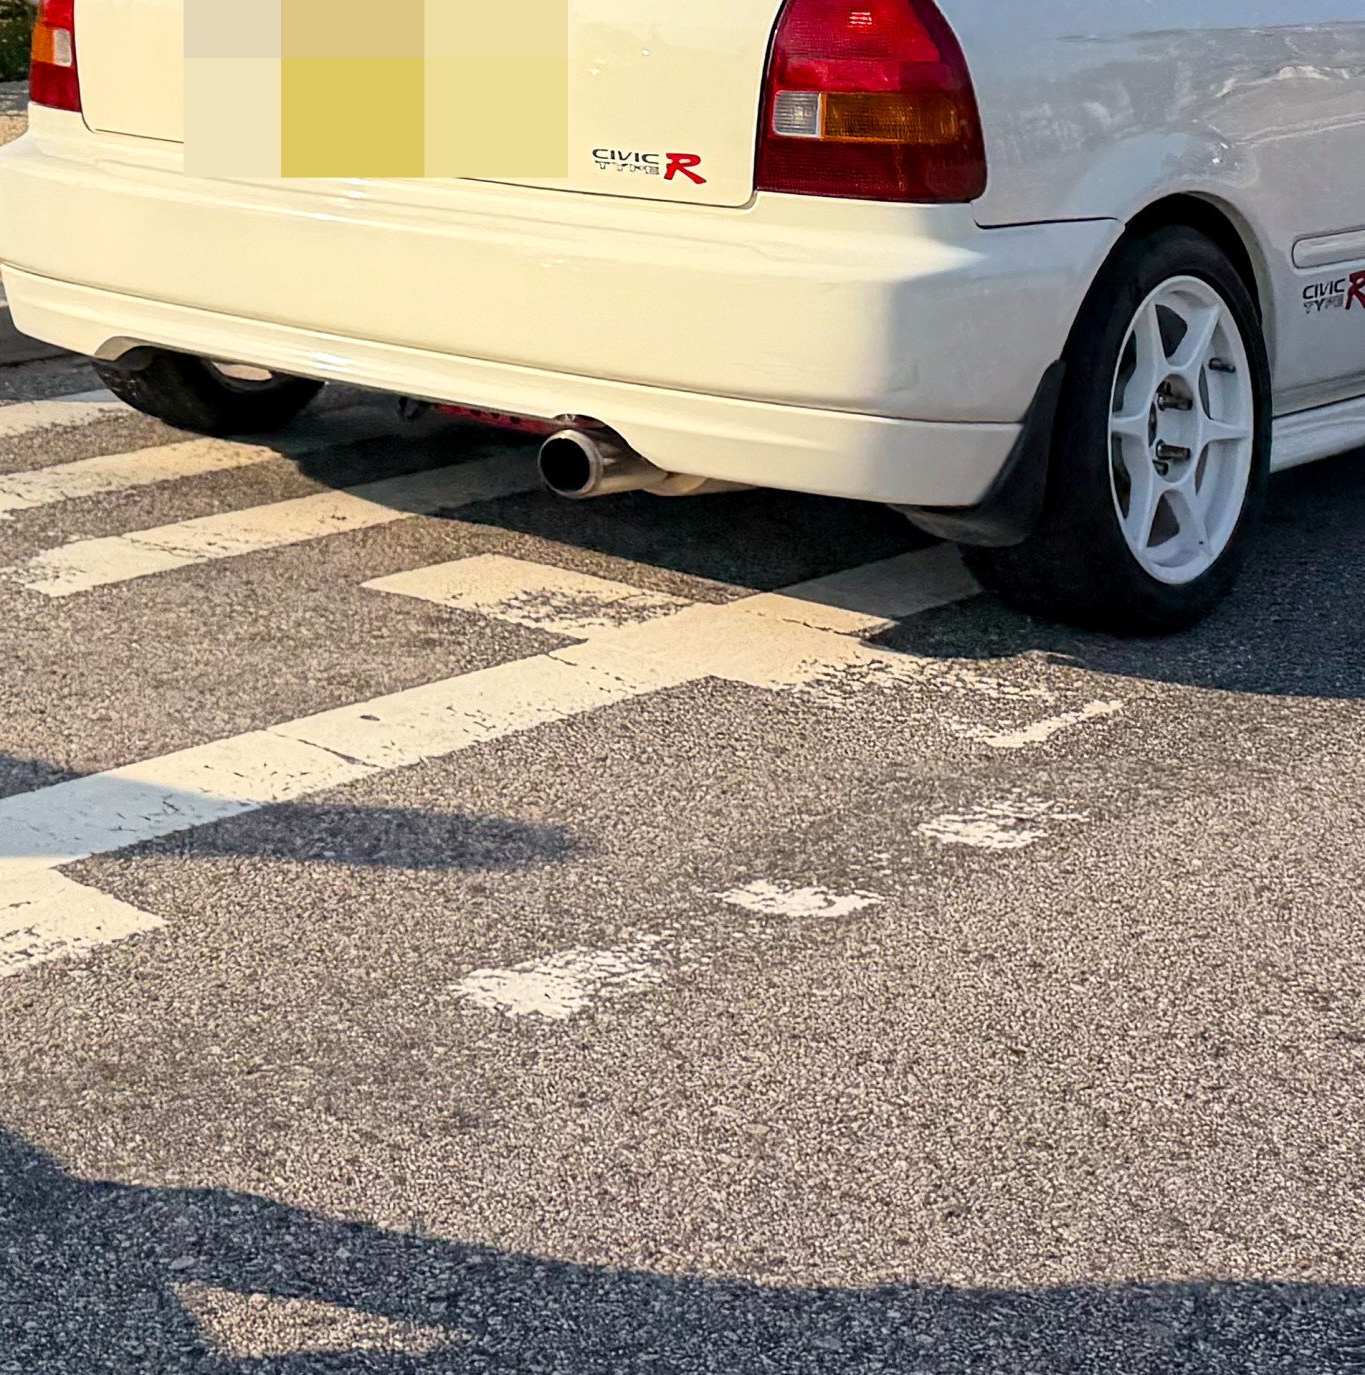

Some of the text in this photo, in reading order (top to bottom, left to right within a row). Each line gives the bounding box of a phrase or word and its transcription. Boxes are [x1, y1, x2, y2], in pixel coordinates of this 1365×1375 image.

[591, 148, 660, 165] CIVIC
[594, 152, 708, 185] TYPE R
[1302, 277, 1346, 300] CIVIC
[1345, 270, 1365, 311] R
